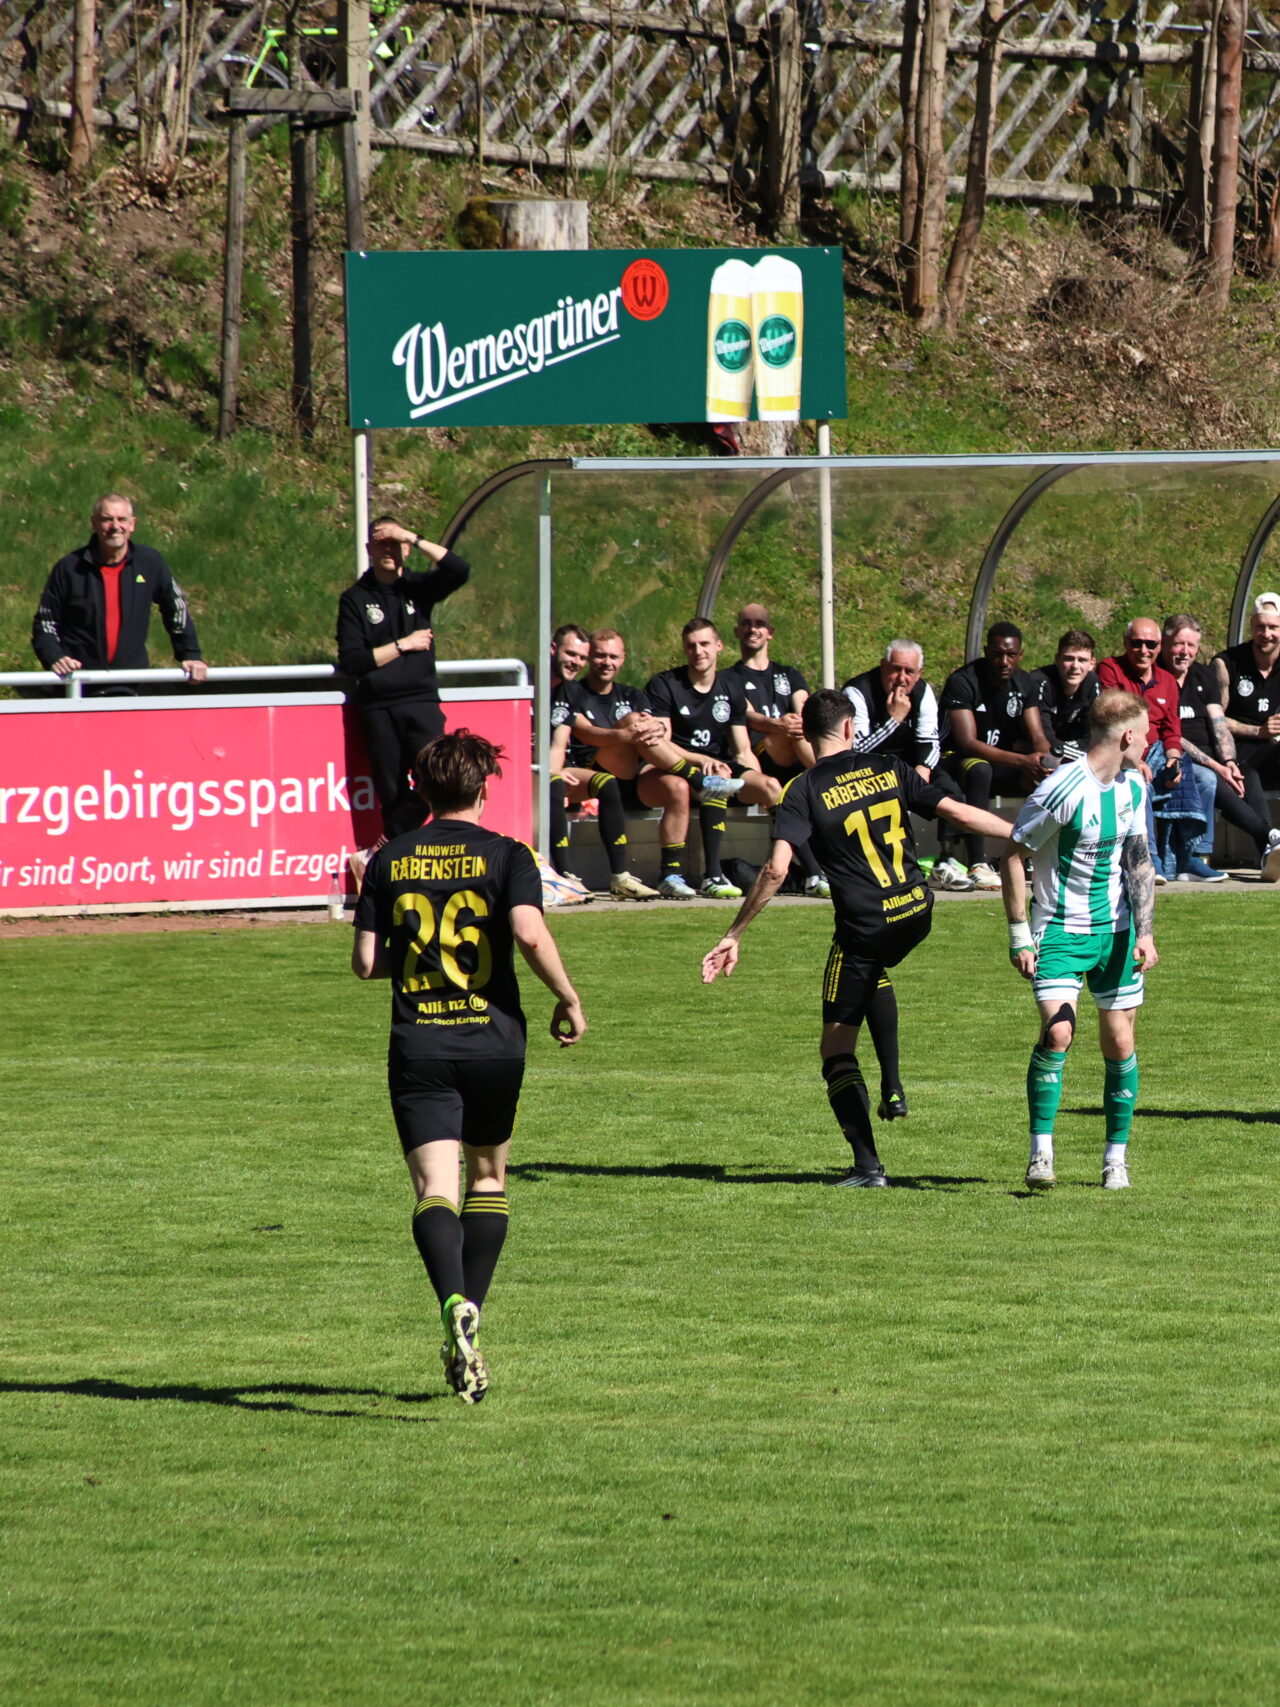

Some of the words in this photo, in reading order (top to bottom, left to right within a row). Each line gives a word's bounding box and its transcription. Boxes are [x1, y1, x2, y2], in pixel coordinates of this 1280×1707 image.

[392, 286, 622, 406] Wernesgrüner
[1258, 698, 1270, 712] 16
[986, 729, 1000, 746] 16
[835, 767, 874, 784] HANDWERK
[0, 762, 383, 836] rzgebirgssparka
[415, 844, 467, 857] HANDWERK
[843, 798, 907, 888] 17
[18, 856, 75, 887] sind
[79, 856, 156, 890] Sport,
[163, 852, 203, 880] wir
[208, 849, 263, 879] sind
[269, 845, 362, 881] Erzgeb
[882, 893, 915, 911] Allianz
[392, 889, 492, 994] 26
